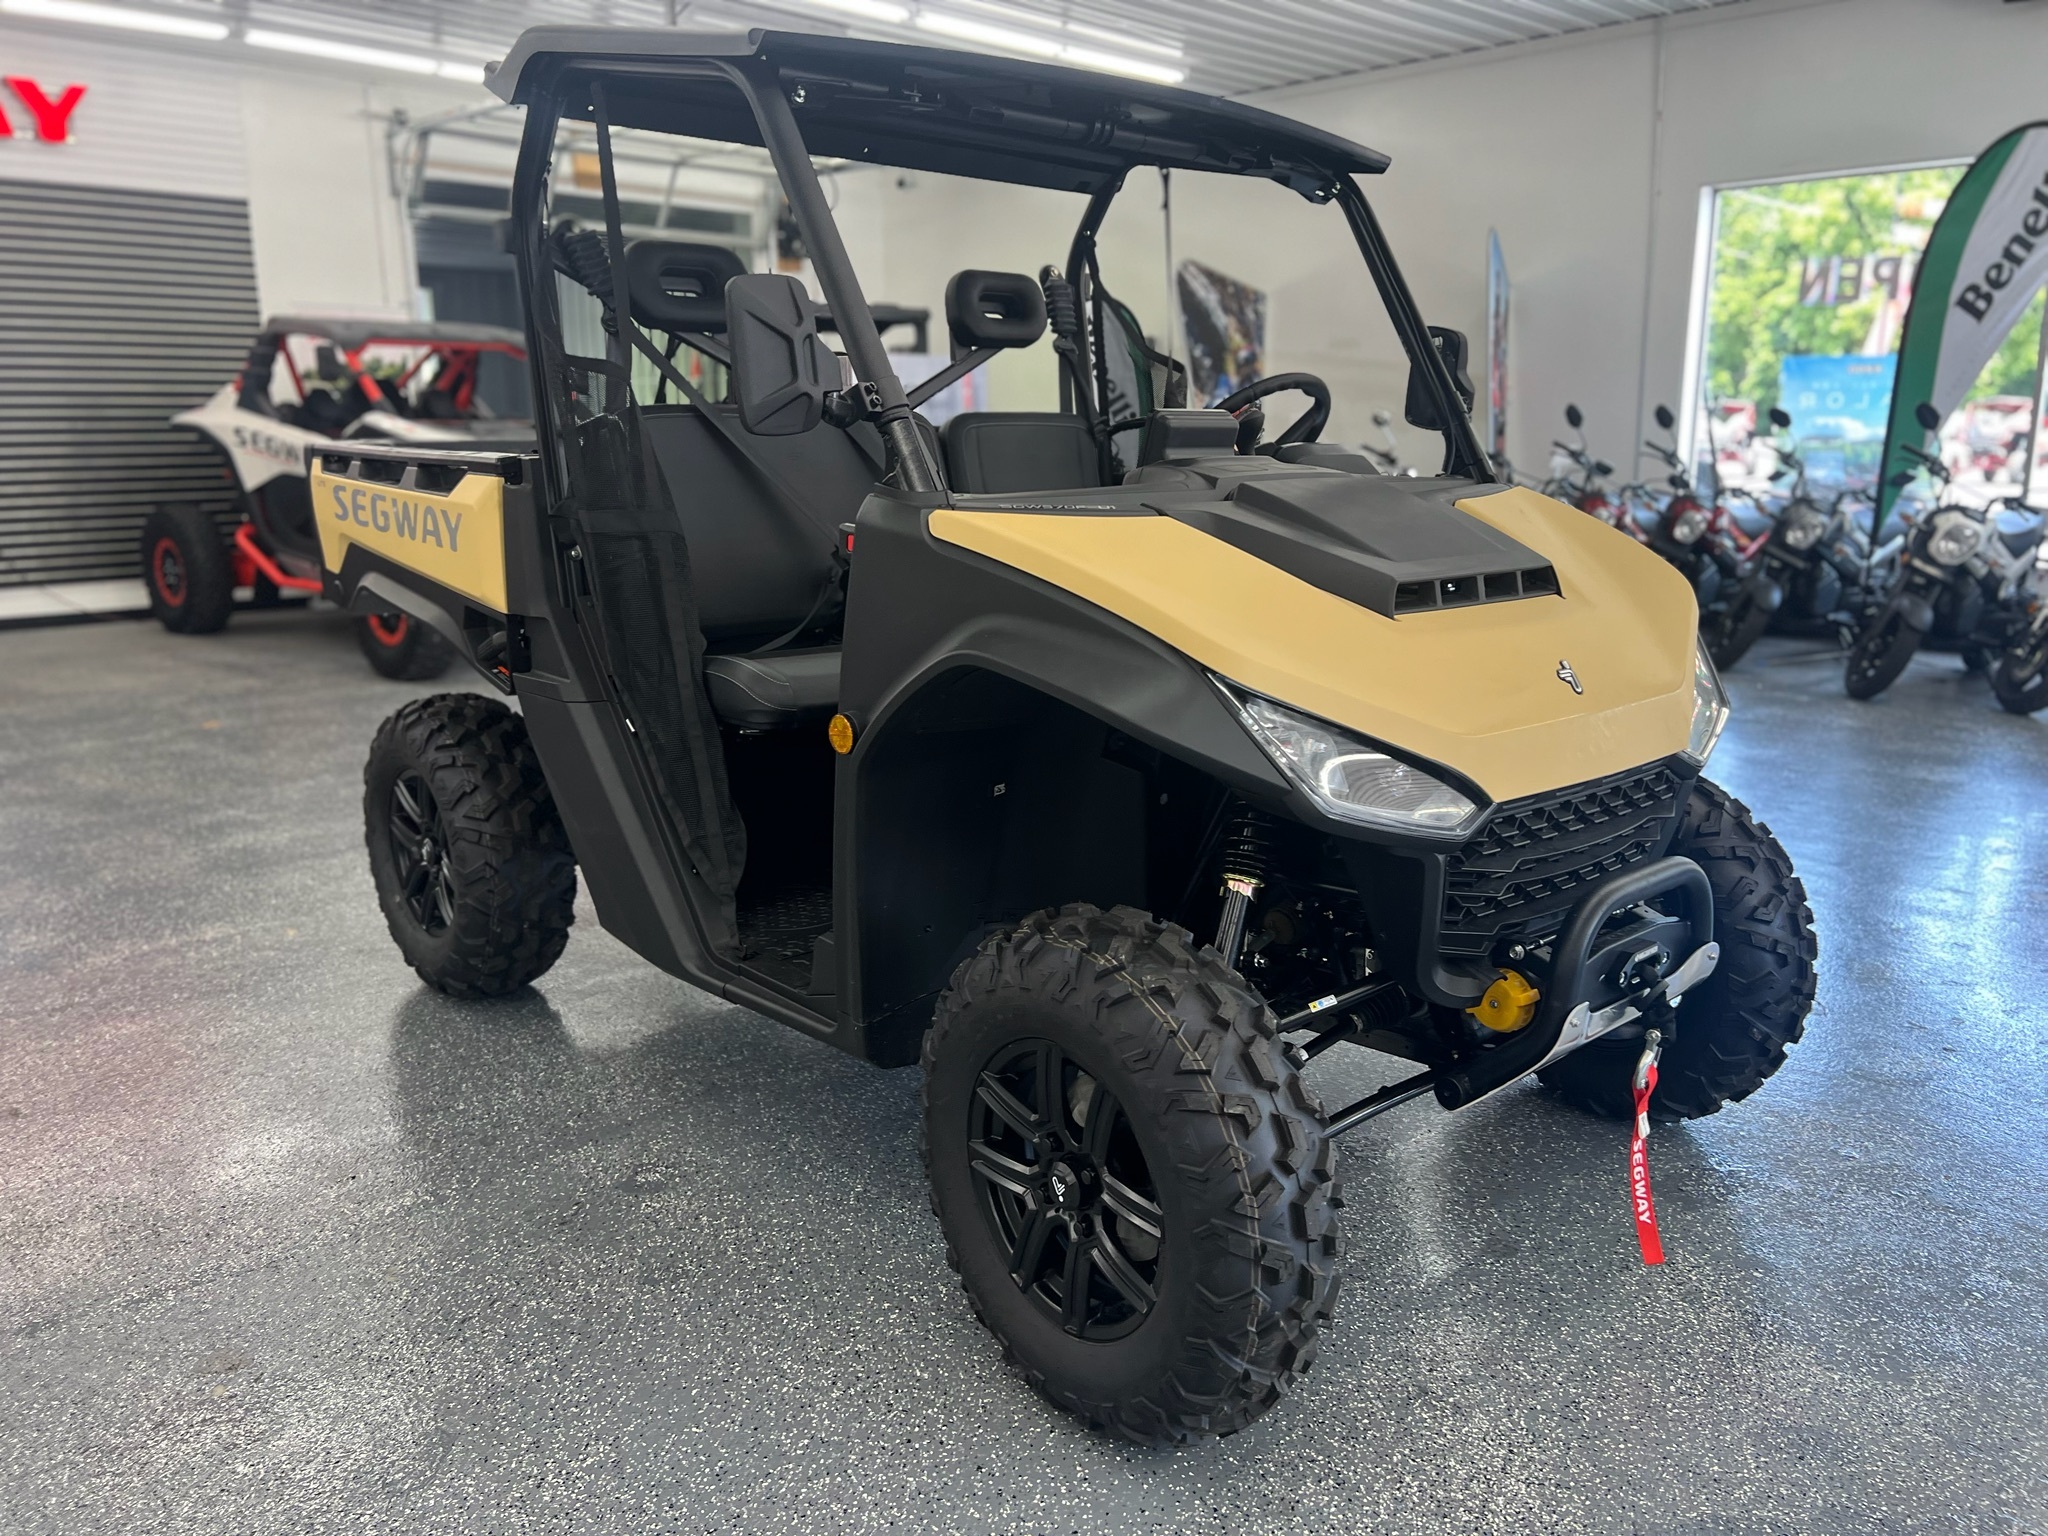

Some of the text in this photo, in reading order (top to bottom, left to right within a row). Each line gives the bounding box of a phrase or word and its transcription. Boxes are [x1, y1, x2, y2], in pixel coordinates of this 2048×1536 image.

[0, 75, 87, 143] Y
[1955, 172, 2048, 324] Benel
[233, 426, 300, 463] SEGW
[332, 484, 463, 553] SEGWAY
[1632, 1138, 1652, 1225] SEGWAY
